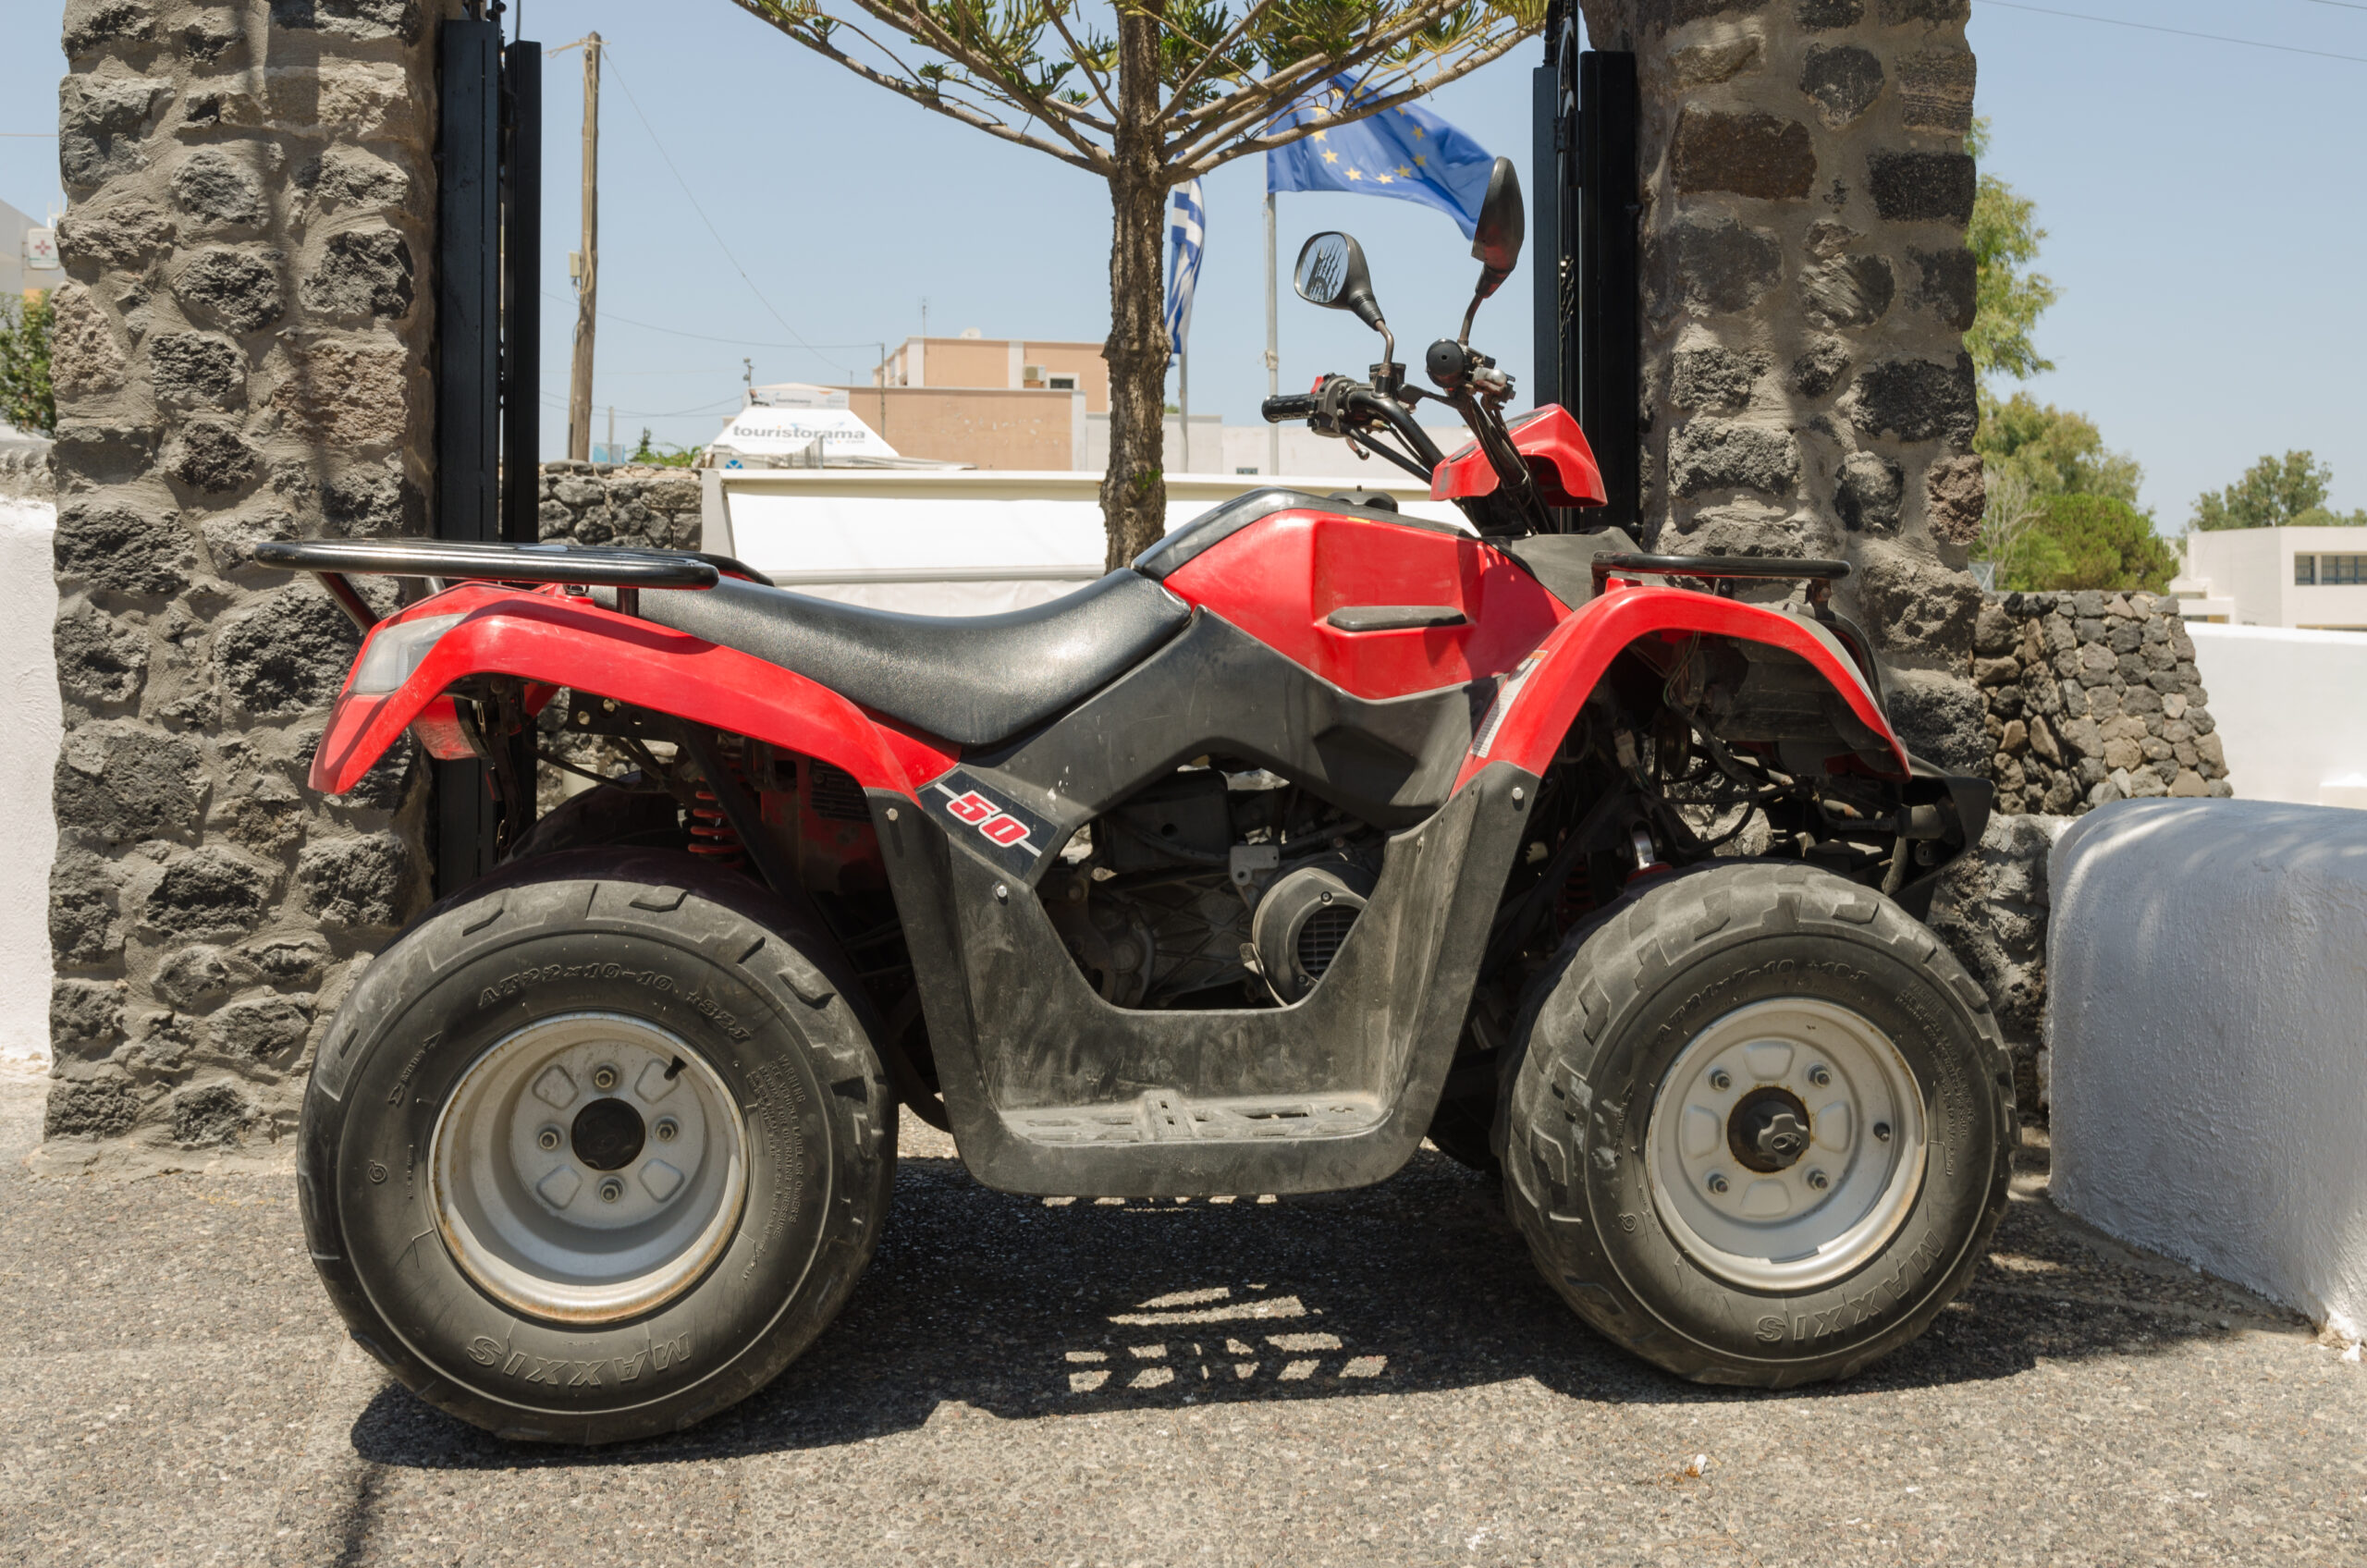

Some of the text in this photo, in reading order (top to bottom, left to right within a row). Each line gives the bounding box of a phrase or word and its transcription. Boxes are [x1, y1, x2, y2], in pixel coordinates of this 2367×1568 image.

[733, 424, 865, 439] touristorama
[946, 790, 1031, 848] 50
[776, 1052, 806, 1103] WARNING
[1754, 1228, 1944, 1342] MAXXIS
[466, 1331, 692, 1387] MAXXIS
